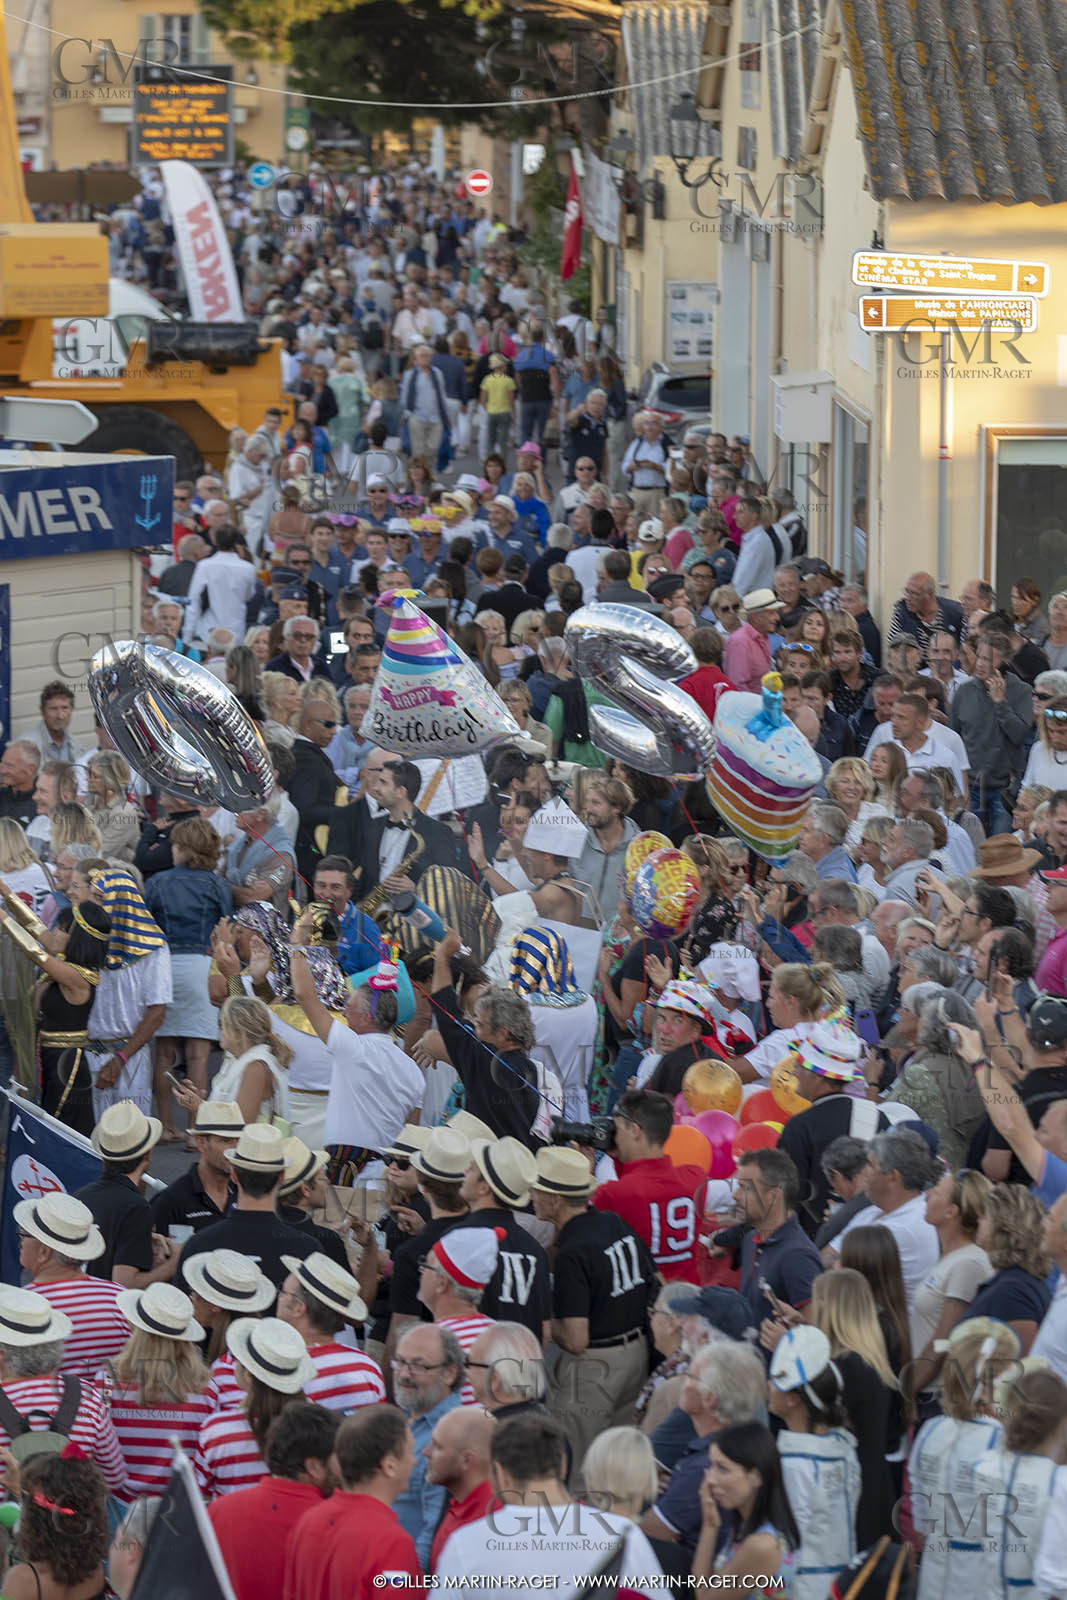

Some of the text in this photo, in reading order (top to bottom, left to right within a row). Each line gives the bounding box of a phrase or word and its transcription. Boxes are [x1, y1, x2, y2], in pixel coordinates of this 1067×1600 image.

[902, 276, 929, 286] STAR
[979, 309, 1031, 318] PAPILLONS
[393, 688, 432, 709] HAPPY
[373, 707, 484, 744] Birthday!
[649, 1196, 696, 1255] 19
[498, 1251, 538, 1306] IV
[603, 1234, 646, 1298] III
